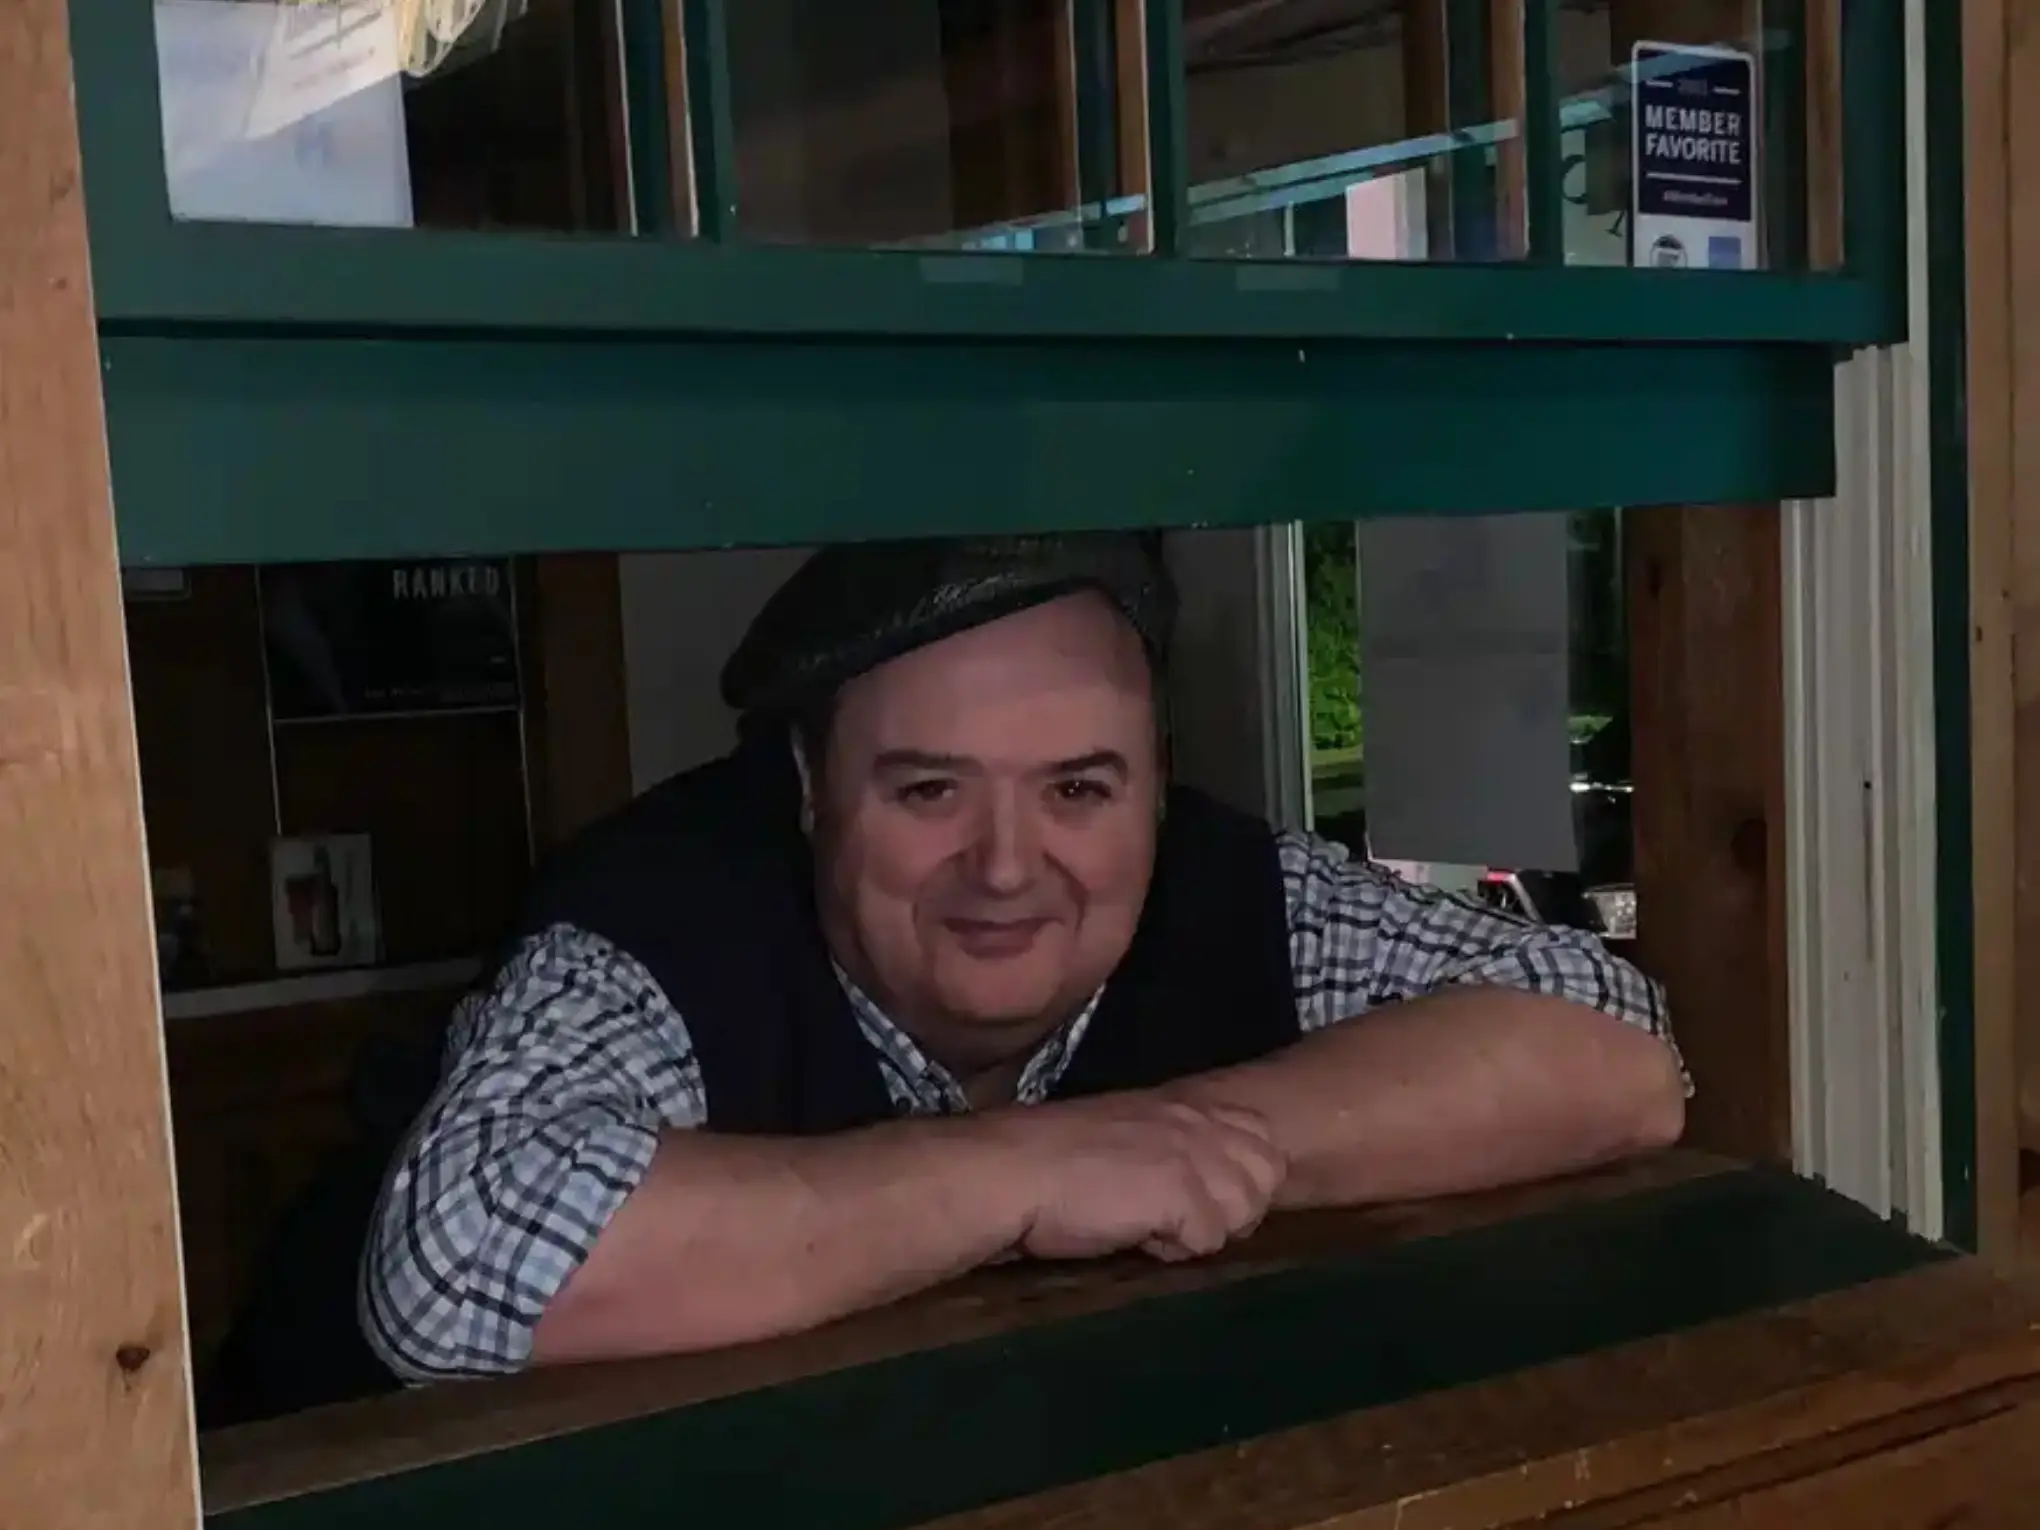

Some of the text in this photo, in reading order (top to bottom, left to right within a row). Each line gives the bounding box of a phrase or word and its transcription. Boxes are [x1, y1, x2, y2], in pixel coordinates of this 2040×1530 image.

[1645, 104, 1742, 136] MEMBER
[1645, 132, 1742, 165] FAVORITE
[392, 565, 500, 600] RANKED
